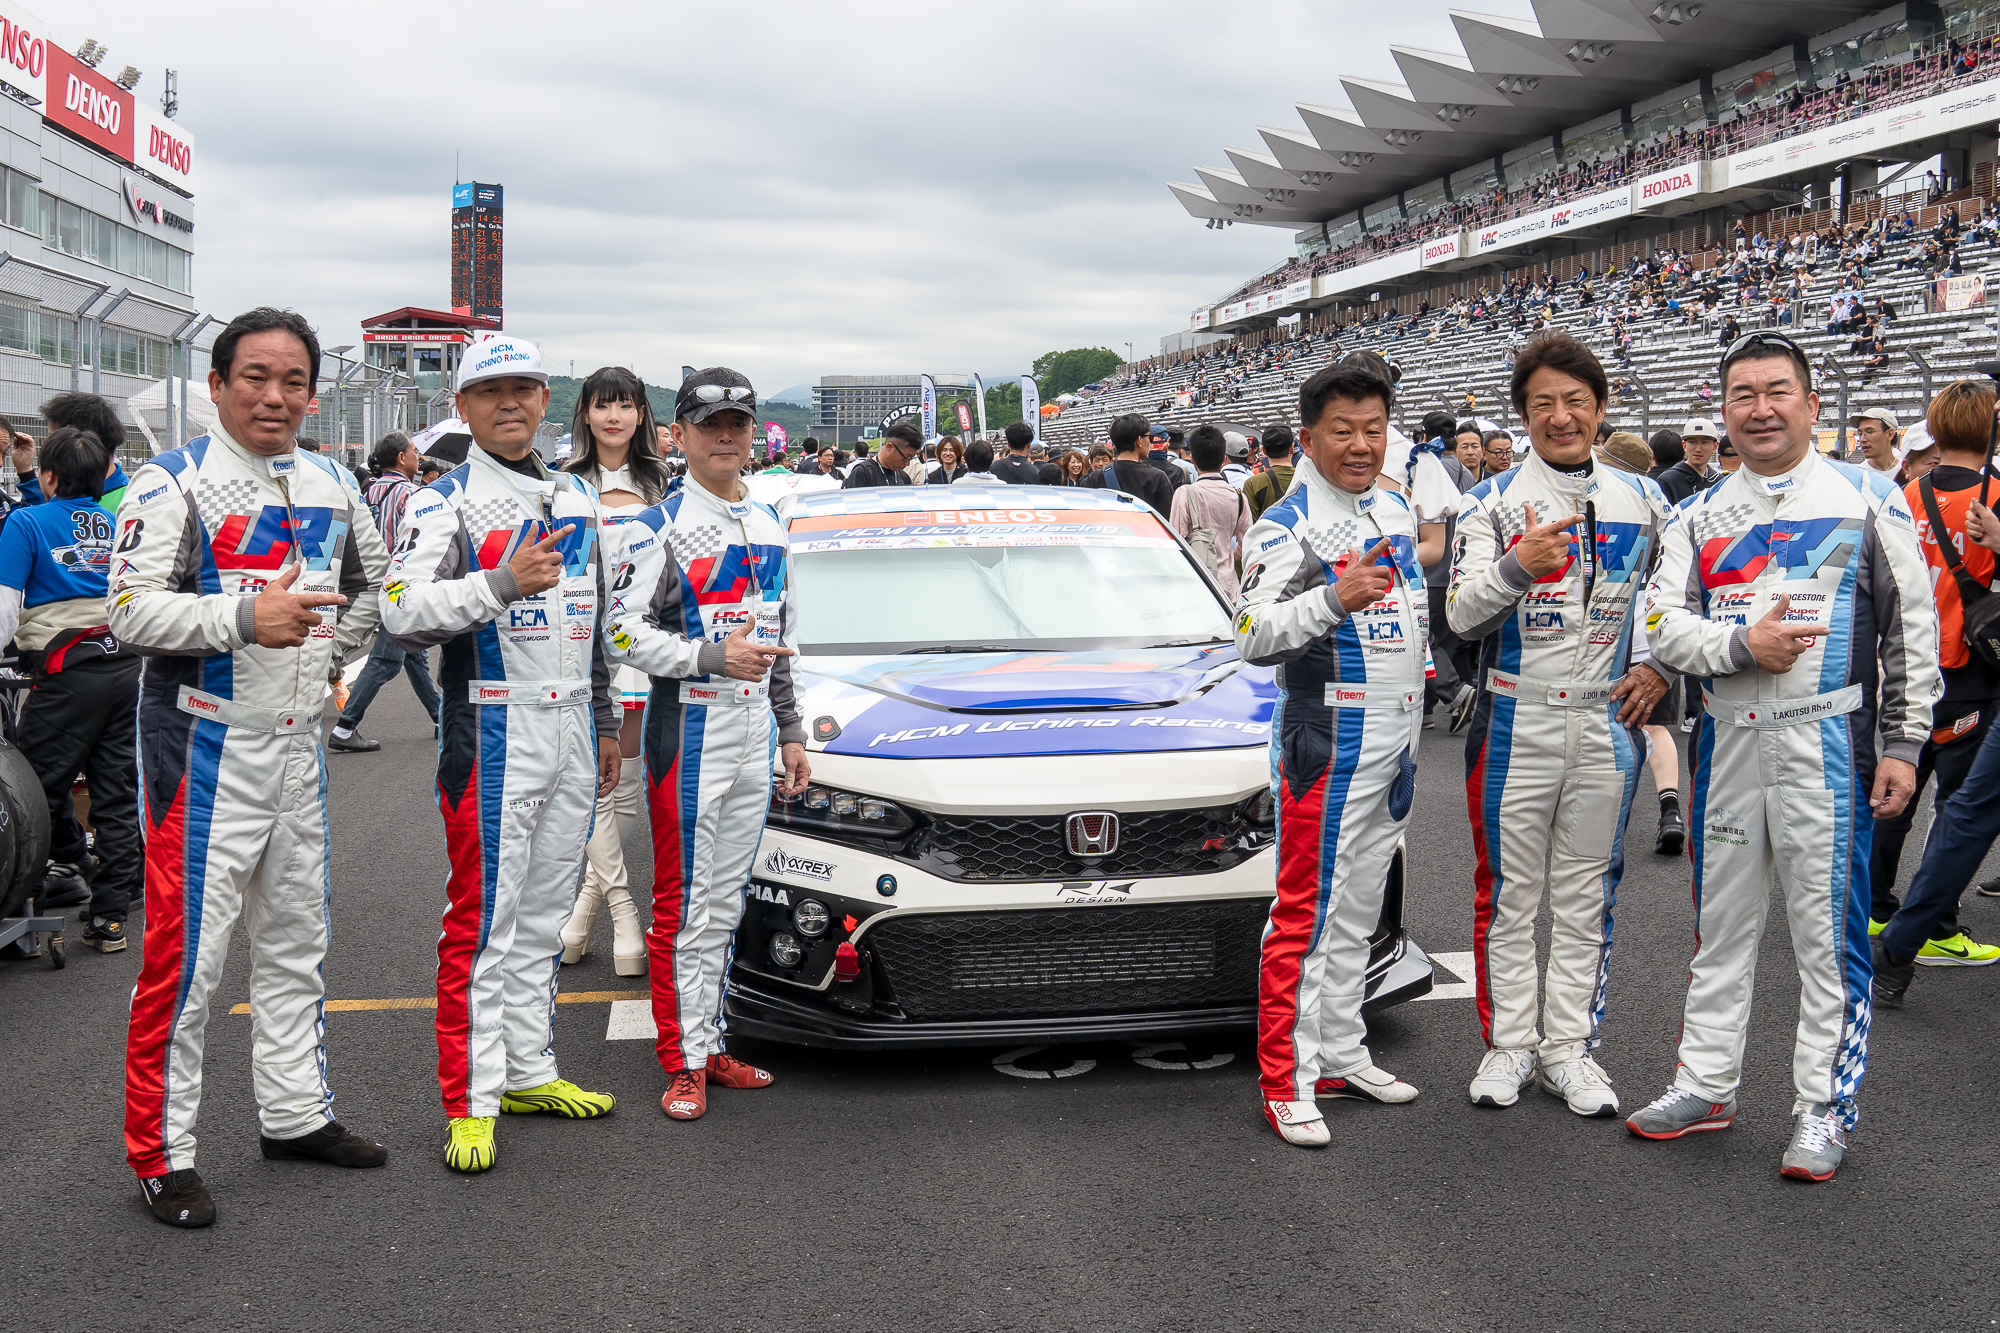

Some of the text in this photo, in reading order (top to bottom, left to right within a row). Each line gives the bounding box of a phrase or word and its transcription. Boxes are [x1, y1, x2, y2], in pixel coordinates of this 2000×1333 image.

[0, 15, 45, 77] NSO
[65, 72, 121, 135] DENSO
[1940, 93, 1996, 115] PORSCHE
[1888, 110, 1922, 124] PORSCHE
[1829, 127, 1875, 146] PORSCHE
[149, 124, 190, 175] DENSO
[1785, 141, 1814, 153] PORSCHE
[1735, 155, 1774, 171] PORSCHE
[1643, 173, 1692, 198] HONDA
[1551, 197, 1628, 229] HRC Honda RACING
[1480, 220, 1546, 248] HRC Honda RACING
[1425, 242, 1455, 259] HONDA
[490, 344, 513, 355] HCM
[475, 353, 530, 371] UCHINO RACING
[273, 460, 296, 472] freem
[1767, 478, 1793, 491] freem
[138, 484, 168, 504] freem
[1358, 494, 1376, 510] freem
[415, 502, 443, 518] freem
[936, 510, 1057, 524] ENEOS
[1888, 505, 1912, 524] freem
[71, 510, 111, 541] 36
[831, 524, 1122, 538] HCM Uchino Racing
[629, 537, 654, 554] freem
[808, 541, 841, 550] HCM
[1261, 534, 1288, 552] freem
[302, 583, 336, 594] BRIDGESTONE
[1524, 591, 1568, 605] HRC
[1592, 595, 1630, 605] BRIDGESTONE
[1717, 592, 1757, 609] HRC
[575, 602, 593, 610] Super
[1601, 608, 1625, 616] Super
[1786, 606, 1820, 615] Super
[510, 609, 548, 627] HCM
[712, 610, 749, 625] HRC
[1525, 612, 1564, 628] HCM
[1600, 615, 1623, 623] Taikyu
[1786, 614, 1819, 622] Taikyu
[310, 622, 335, 639] BBS
[570, 625, 592, 640] BBS
[1368, 622, 1404, 640] HCM
[1588, 630, 1618, 645] BBS
[1492, 675, 1517, 691] freem
[479, 687, 510, 698] freem
[689, 687, 718, 699] freem
[1336, 689, 1366, 701] freem
[1581, 691, 1598, 700] J.DOI
[188, 695, 219, 713] freem
[1772, 706, 1810, 720] T.AKUTSU
[868, 716, 1269, 748] HCM Uchino Racing
[1202, 838, 1224, 850] R
[1708, 835, 1729, 843] GREEN
[747, 883, 790, 906] PIAA
[1064, 896, 1127, 904] DESIGN
